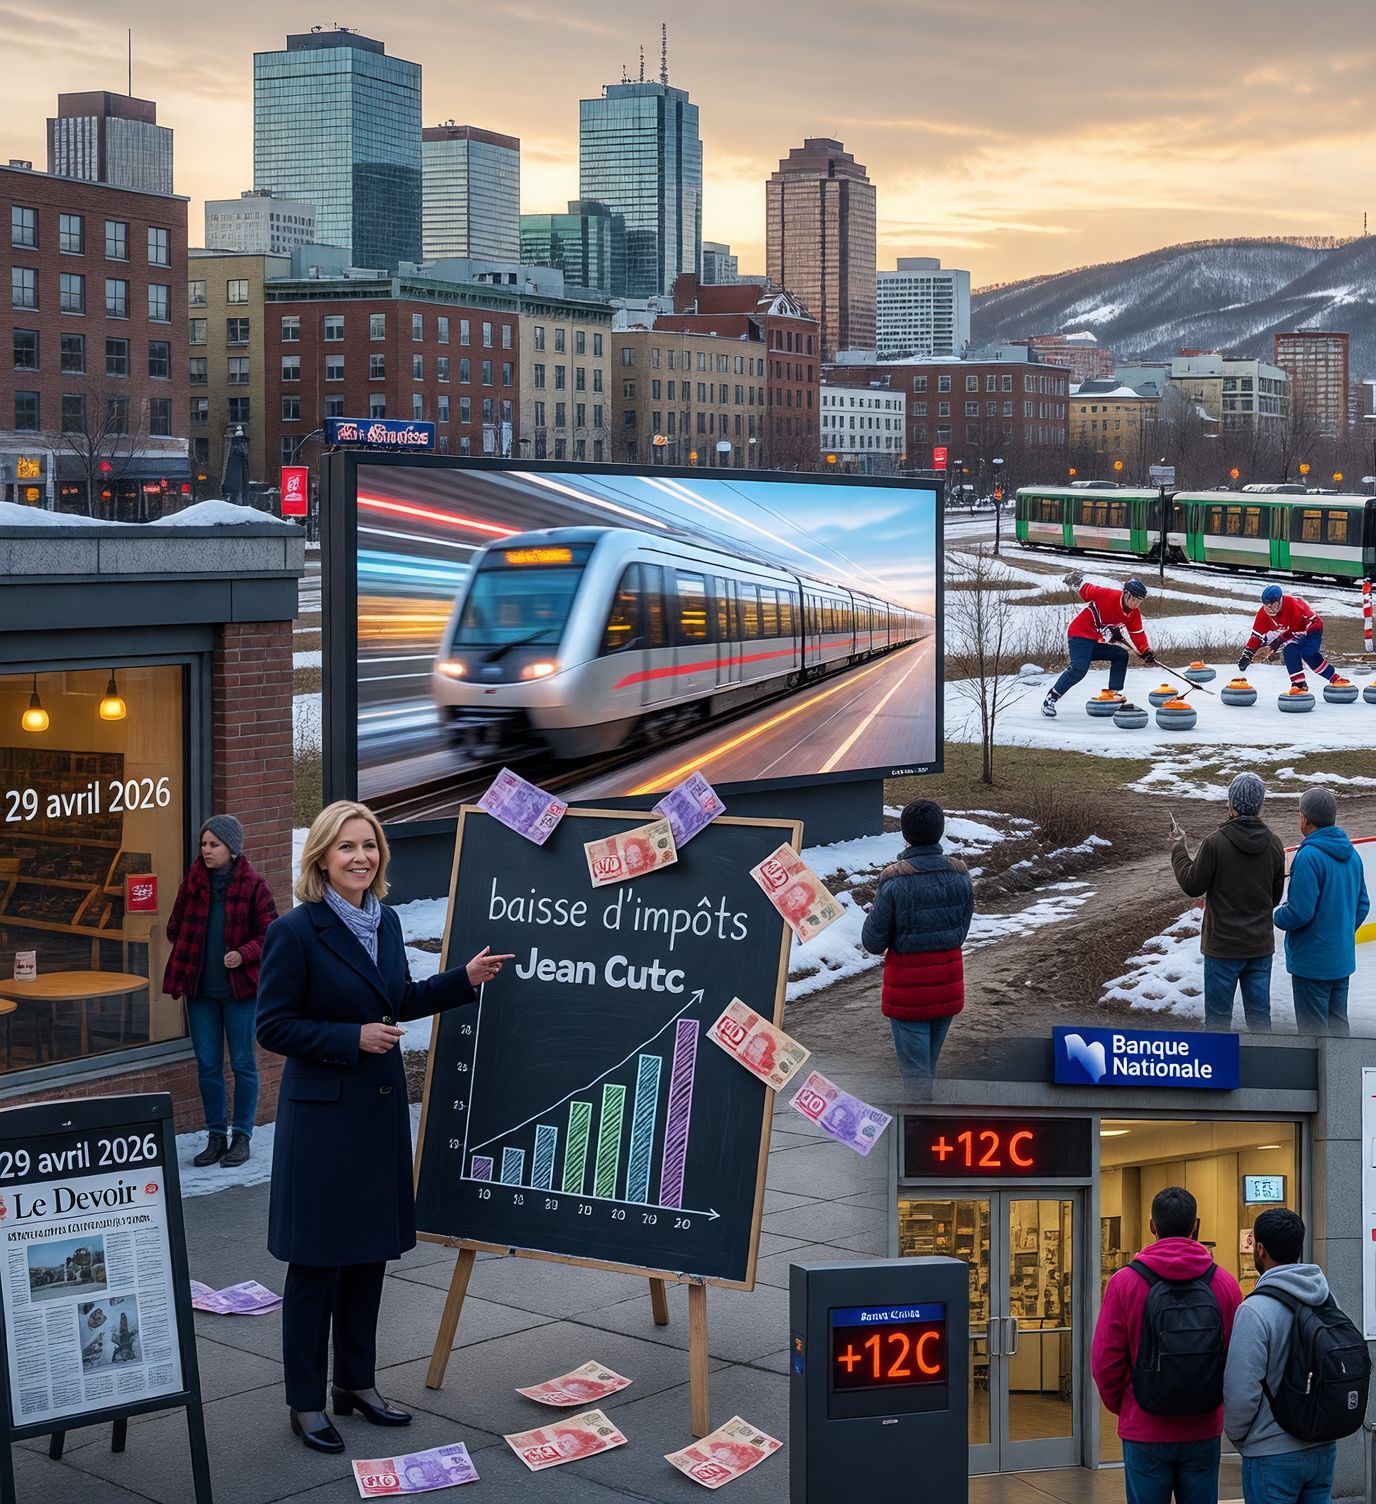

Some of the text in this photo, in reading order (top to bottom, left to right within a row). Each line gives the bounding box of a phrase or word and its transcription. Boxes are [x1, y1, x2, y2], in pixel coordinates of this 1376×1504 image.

[5, 776, 171, 822] 29 avril 2026
[488, 877, 748, 951] baisse d'impôts
[515, 947, 596, 985] Jean
[1112, 1034, 1190, 1060] Banque
[1113, 1056, 1213, 1079] Nationale
[0, 1132, 158, 1179] 29 avril 2026
[12, 1179, 137, 1220] Le Devoir
[838, 1331, 941, 1378] +12C
